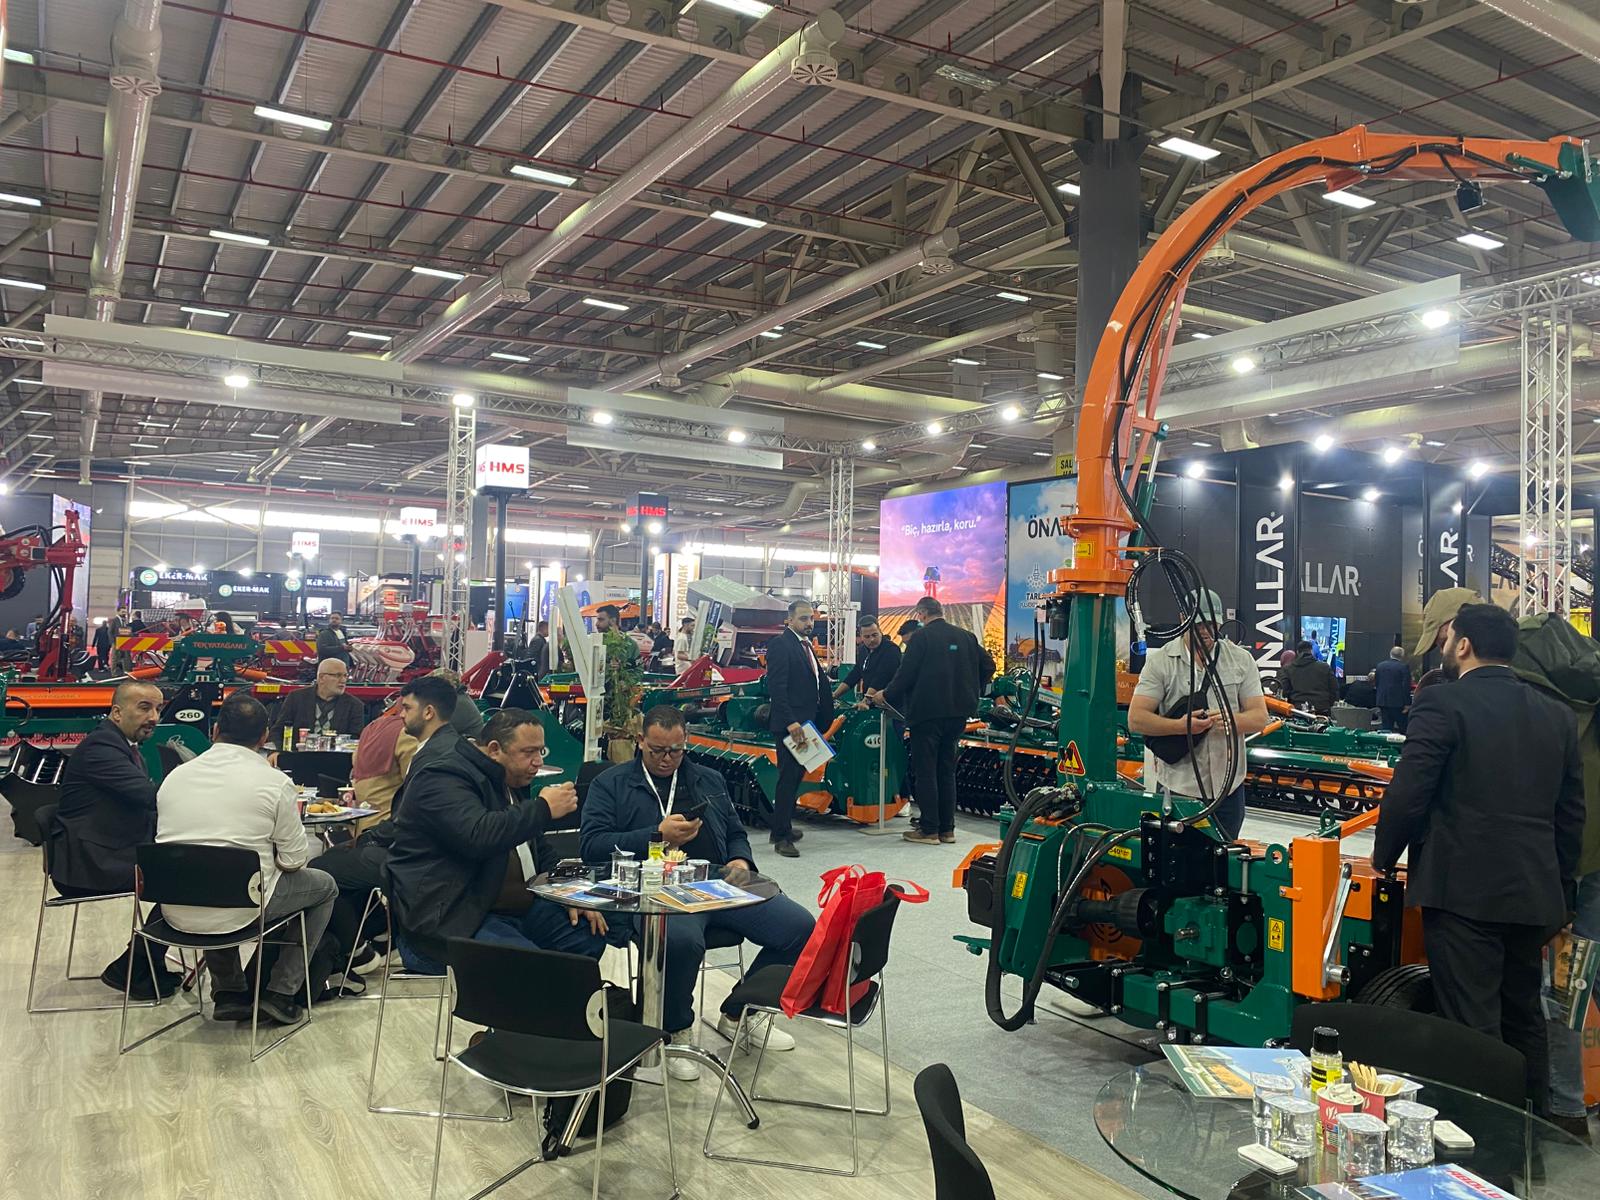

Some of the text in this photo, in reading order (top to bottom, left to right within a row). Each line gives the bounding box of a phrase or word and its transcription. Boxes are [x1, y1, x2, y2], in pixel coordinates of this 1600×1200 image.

[489, 461, 525, 475] HMS
[640, 506, 666, 517] HMS
[409, 518, 434, 527] HMS
[921, 520, 952, 535] hazırla,
[954, 515, 982, 531] koru."
[159, 571, 208, 581] EKER-MAK
[232, 585, 270, 594] EKER-MAK
[180, 711, 201, 719] 260
